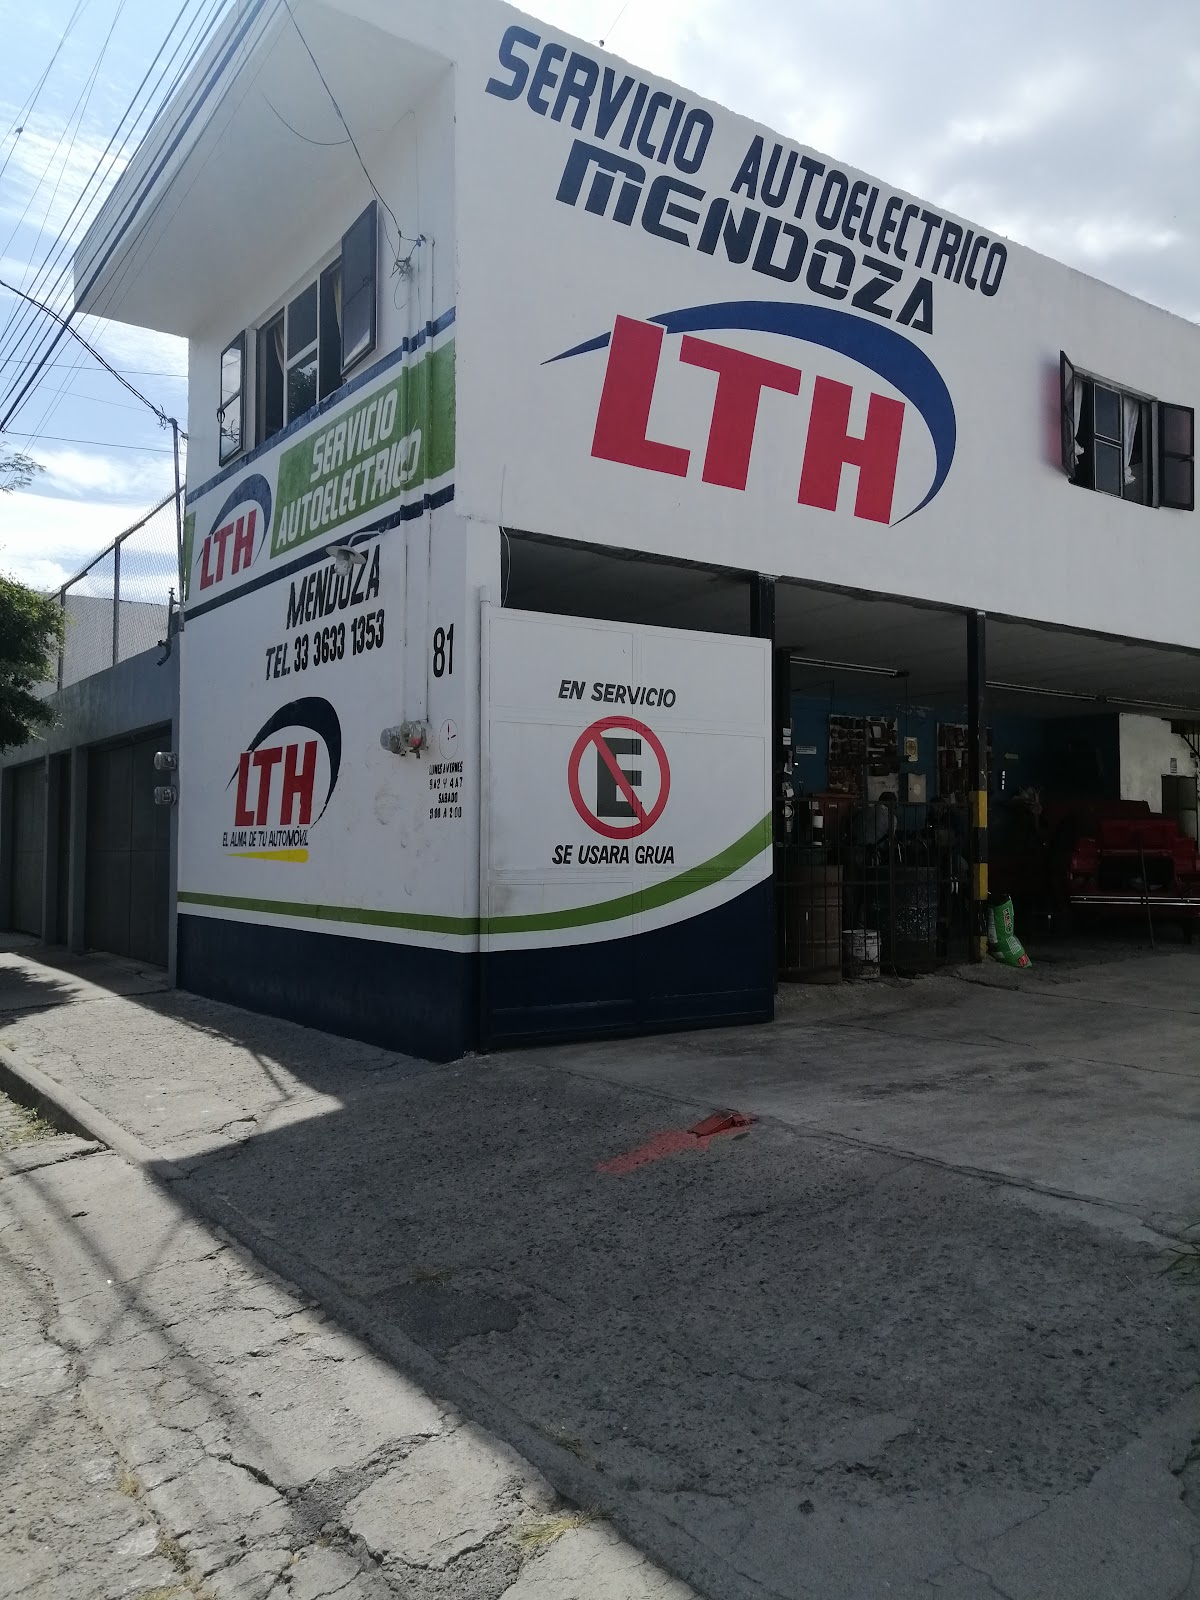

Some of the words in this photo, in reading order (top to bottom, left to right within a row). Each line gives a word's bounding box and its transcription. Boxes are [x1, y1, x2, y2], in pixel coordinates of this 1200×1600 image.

[485, 25, 714, 175] SERVICIO
[731, 135, 1008, 297] AUTOELECTRICO
[556, 139, 933, 335] MENDOZA
[310, 388, 398, 483] SERVICIO
[591, 314, 905, 524] LTH
[276, 428, 422, 549] AUTOELECTRICO
[199, 508, 257, 591] LTH
[286, 544, 381, 630] MENDOZA
[266, 643, 291, 680] TEL.
[294, 634, 309, 672] 33
[313, 622, 345, 667] 3633
[351, 609, 385, 656] 1353
[433, 623, 455, 678] 81
[558, 679, 586, 700] EN
[591, 682, 676, 708] SERVICIO
[235, 740, 318, 827] LTH
[597, 737, 642, 817] E
[222, 832, 229, 847] EL
[229, 831, 247, 847] ALMA
[248, 831, 257, 847] DE
[258, 830, 268, 847] TU
[552, 844, 573, 865] SE
[578, 845, 630, 865] USARA
[635, 845, 675, 865] GRUA
